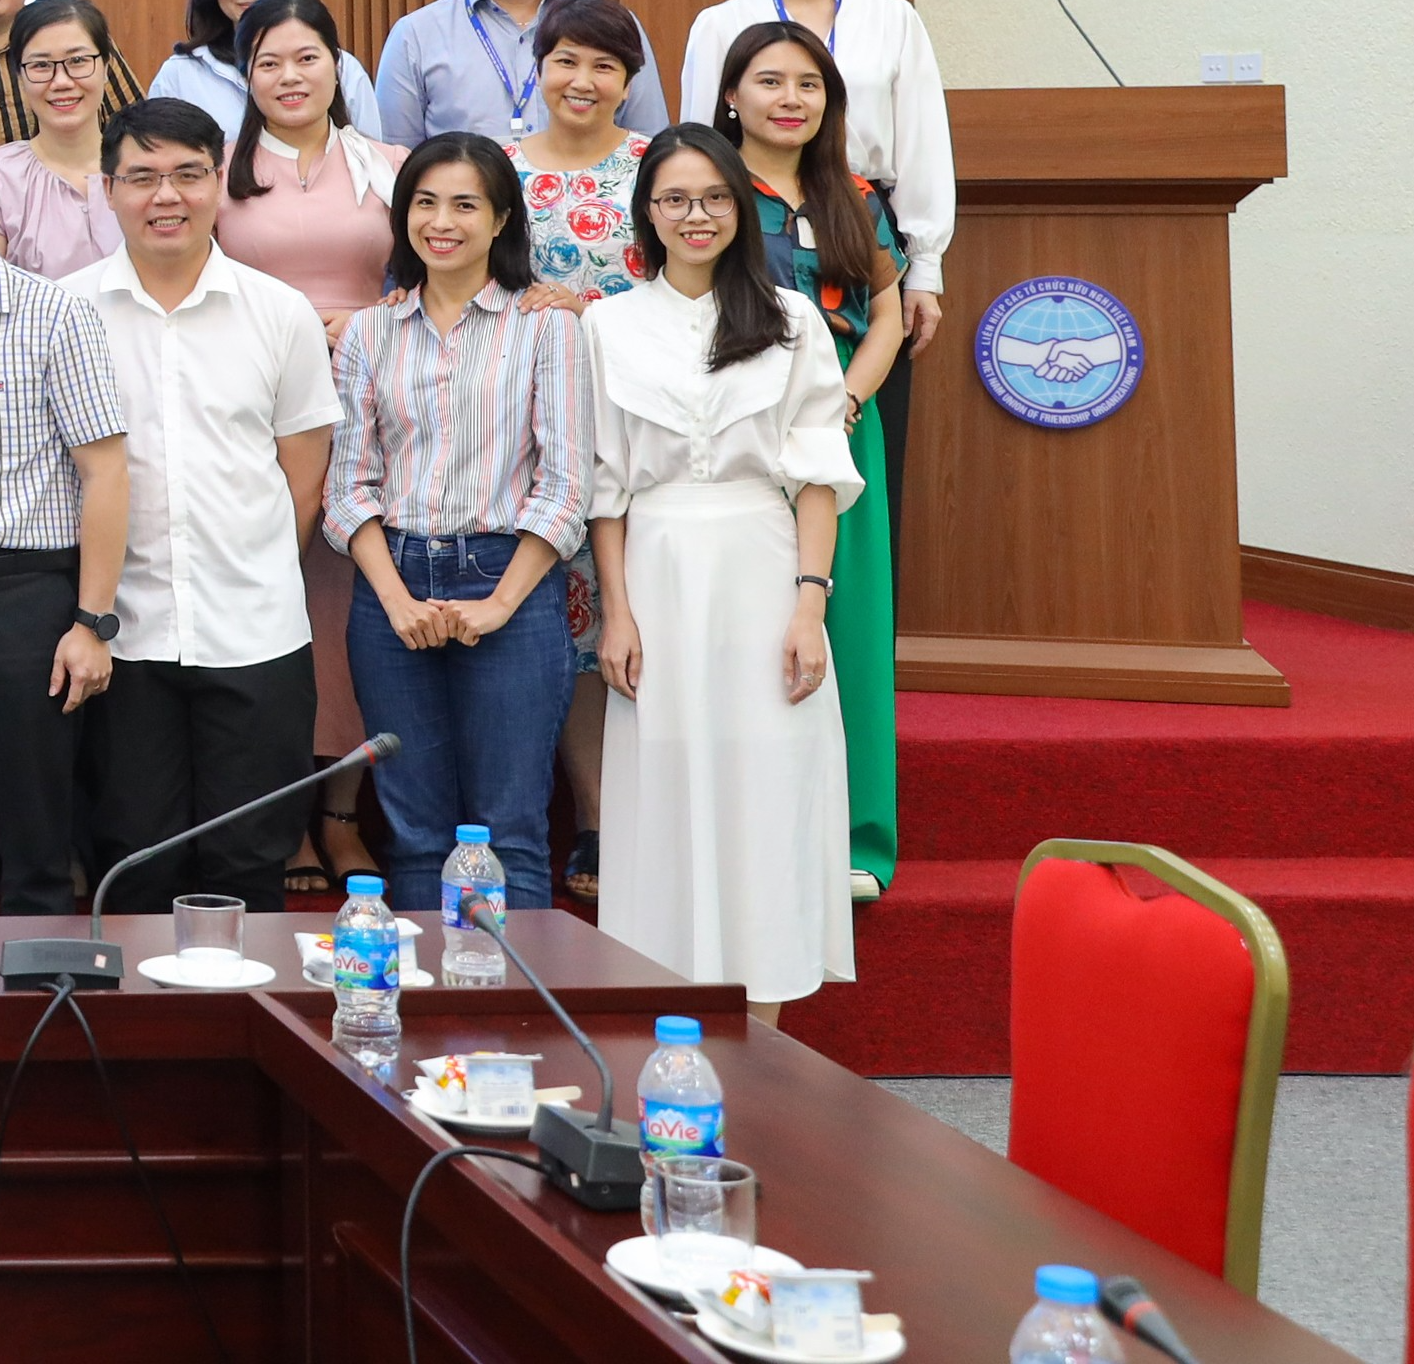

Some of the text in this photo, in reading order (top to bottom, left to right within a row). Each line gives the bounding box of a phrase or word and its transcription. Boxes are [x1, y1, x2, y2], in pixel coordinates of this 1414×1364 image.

[1122, 325, 1138, 348] NAM
[1002, 392, 1028, 415] UNION
[1026, 409, 1039, 419] OF
[1039, 411, 1091, 424] FRIENDSHIP
[1091, 365, 1138, 418] ORGANIZATIONS
